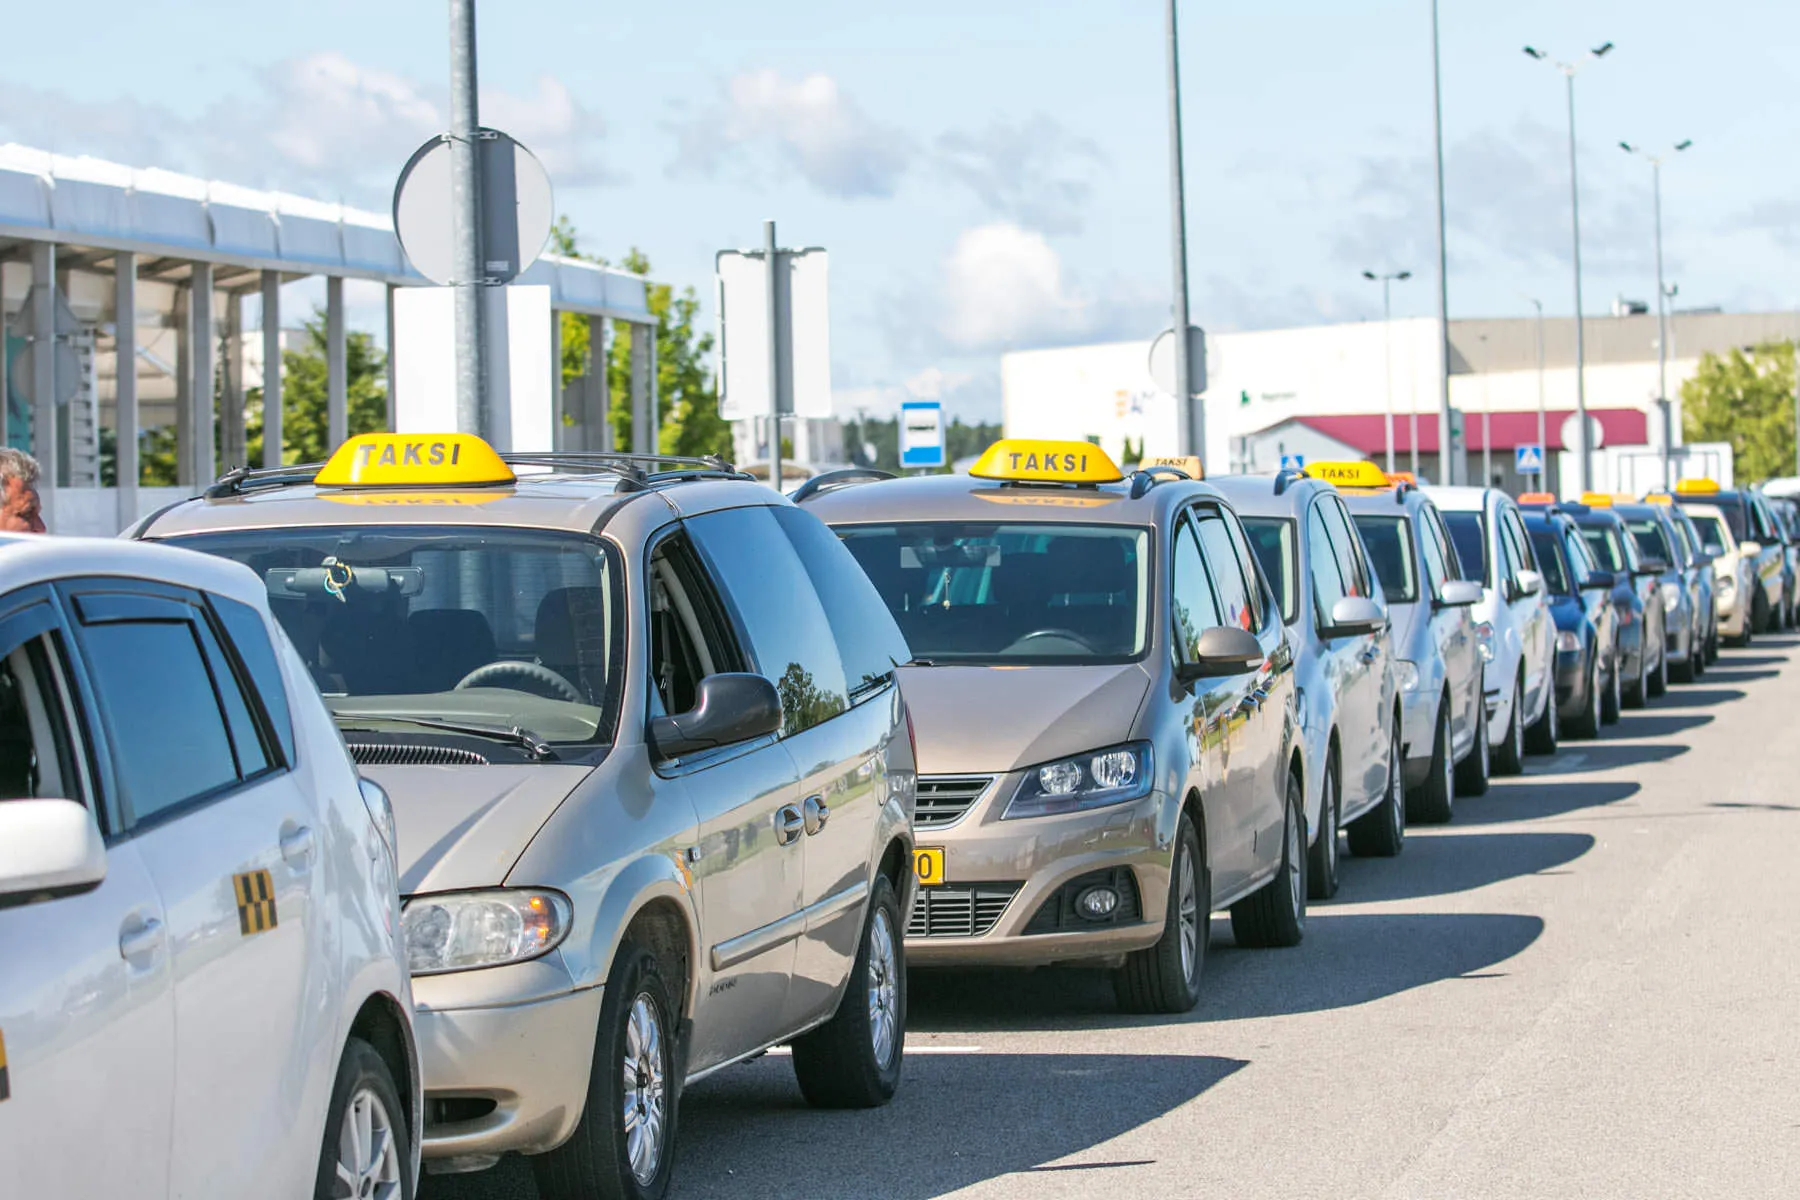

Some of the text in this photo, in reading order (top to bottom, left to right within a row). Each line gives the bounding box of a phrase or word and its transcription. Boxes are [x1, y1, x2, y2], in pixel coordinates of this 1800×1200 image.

[359, 442, 460, 467] TAKSI
[1009, 452, 1087, 473] TAKSI
[1155, 458, 1187, 466] TAKSI
[1320, 468, 1360, 480] TAKSI
